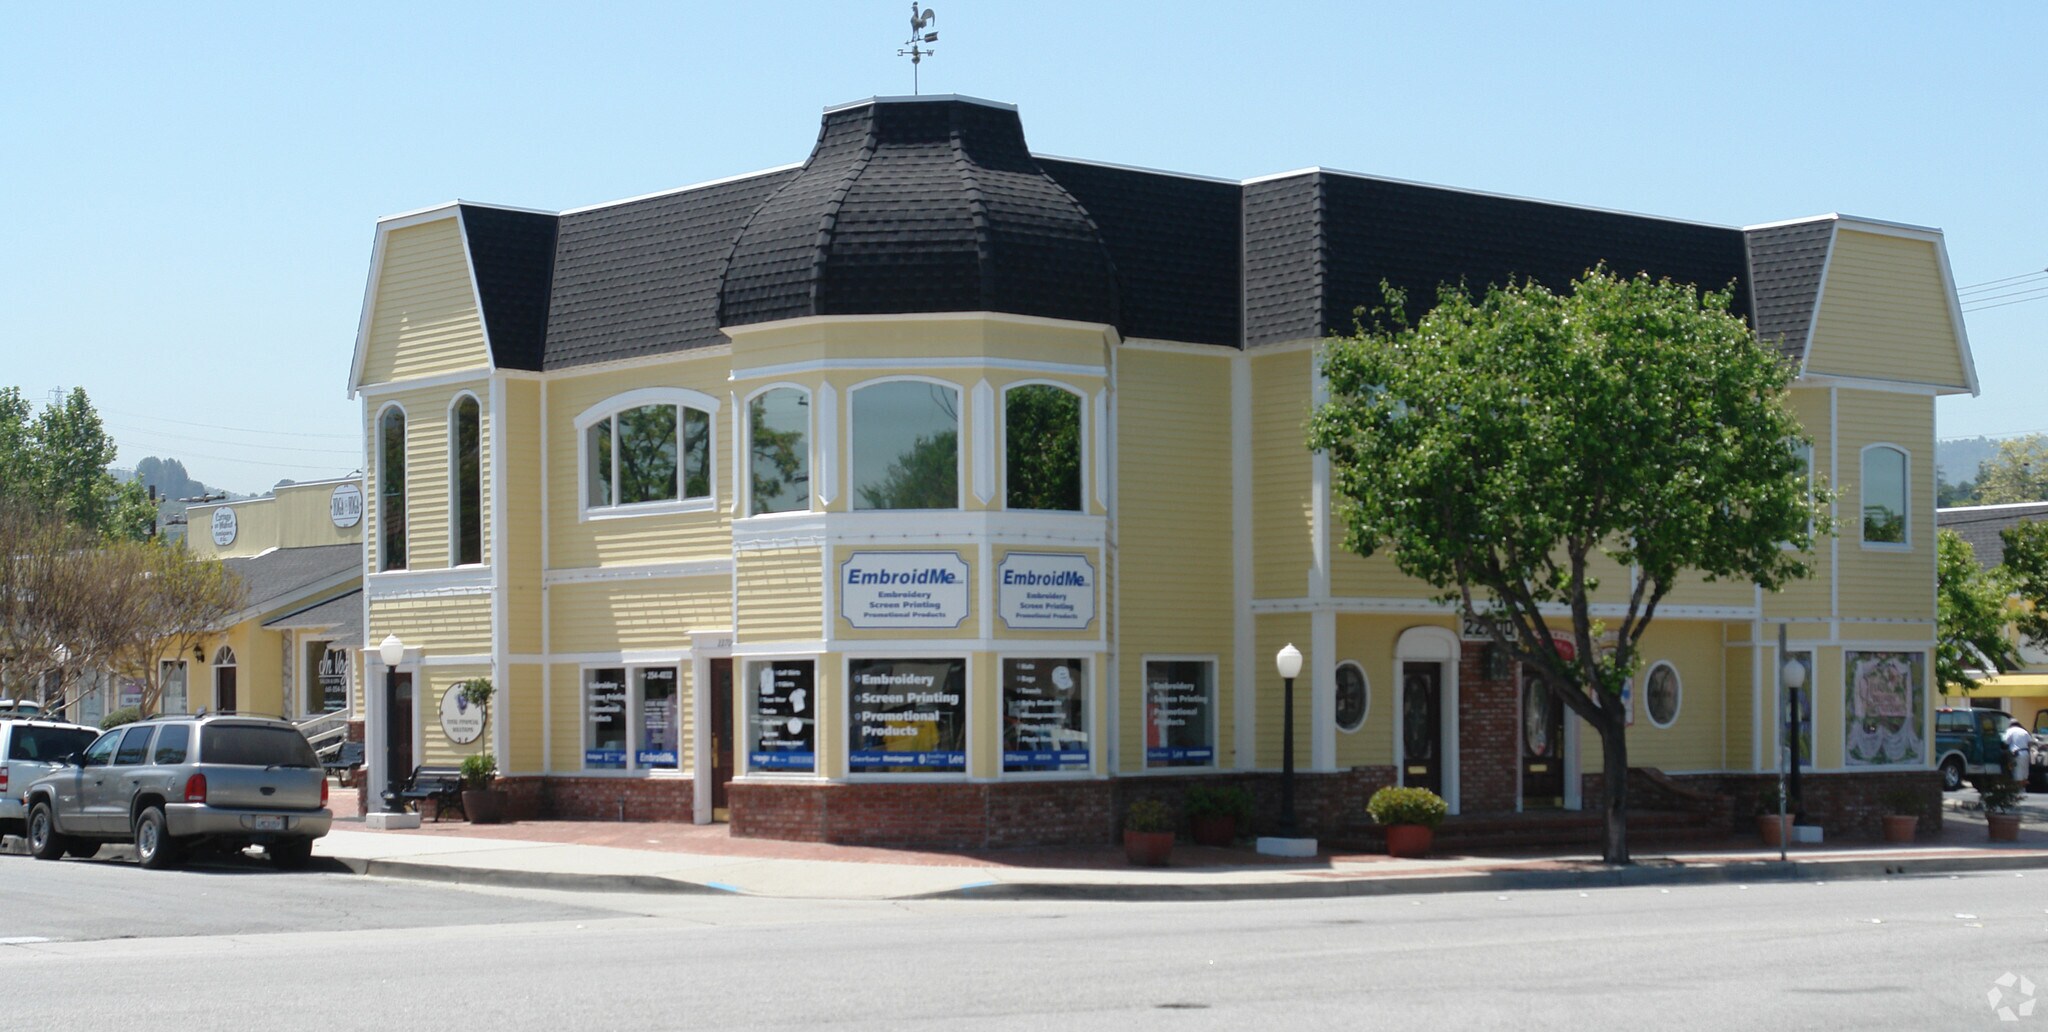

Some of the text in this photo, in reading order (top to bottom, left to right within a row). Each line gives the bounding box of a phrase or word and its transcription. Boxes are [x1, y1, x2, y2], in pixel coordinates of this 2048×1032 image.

[878, 591, 931, 599] Embroidery
[1026, 592, 1066, 600] Embroidery
[903, 601, 941, 610] Printing
[1045, 602, 1074, 611] Printing
[862, 674, 934, 687] Embroidery
[588, 681, 618, 690] Embroidery
[1153, 682, 1194, 691] Embroidery
[862, 692, 959, 706] Screen Printing
[1154, 695, 1208, 704] Screen Printing
[862, 710, 940, 722] Promotional
[862, 726, 918, 736] Products
